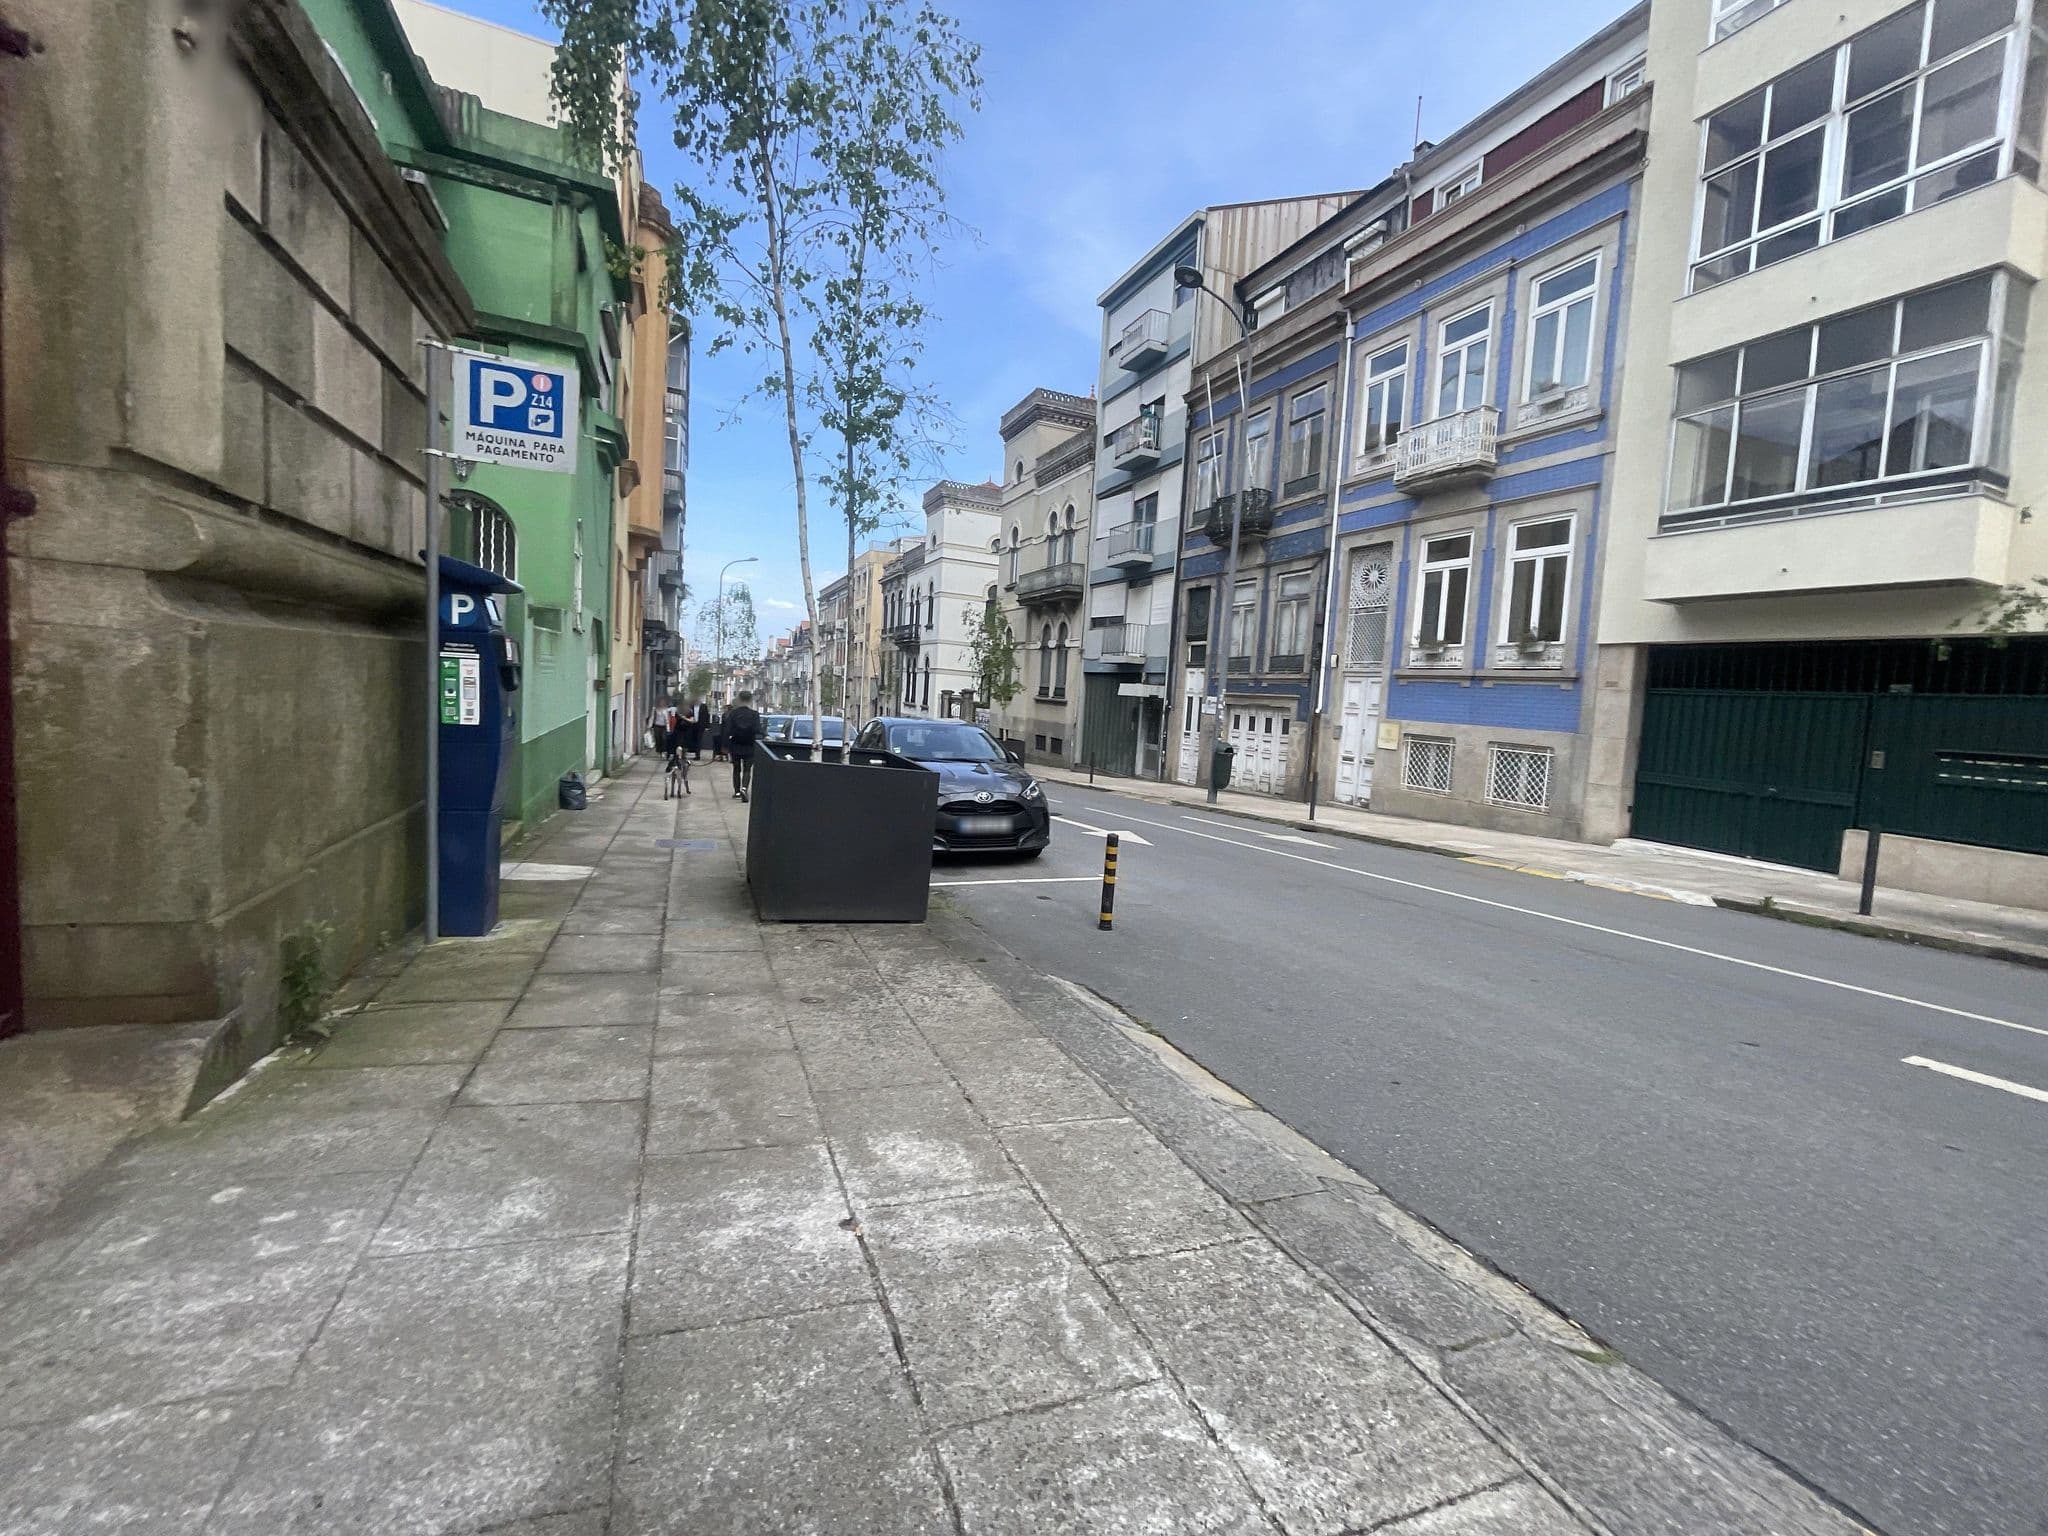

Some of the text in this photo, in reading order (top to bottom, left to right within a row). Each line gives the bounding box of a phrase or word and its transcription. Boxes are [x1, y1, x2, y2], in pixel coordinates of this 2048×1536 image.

[480, 367, 527, 424] P
[531, 393, 553, 409] Z14
[465, 431, 566, 454] MÁQUINA PARA
[477, 444, 554, 463] PAGAMENTO
[451, 593, 475, 625] P
